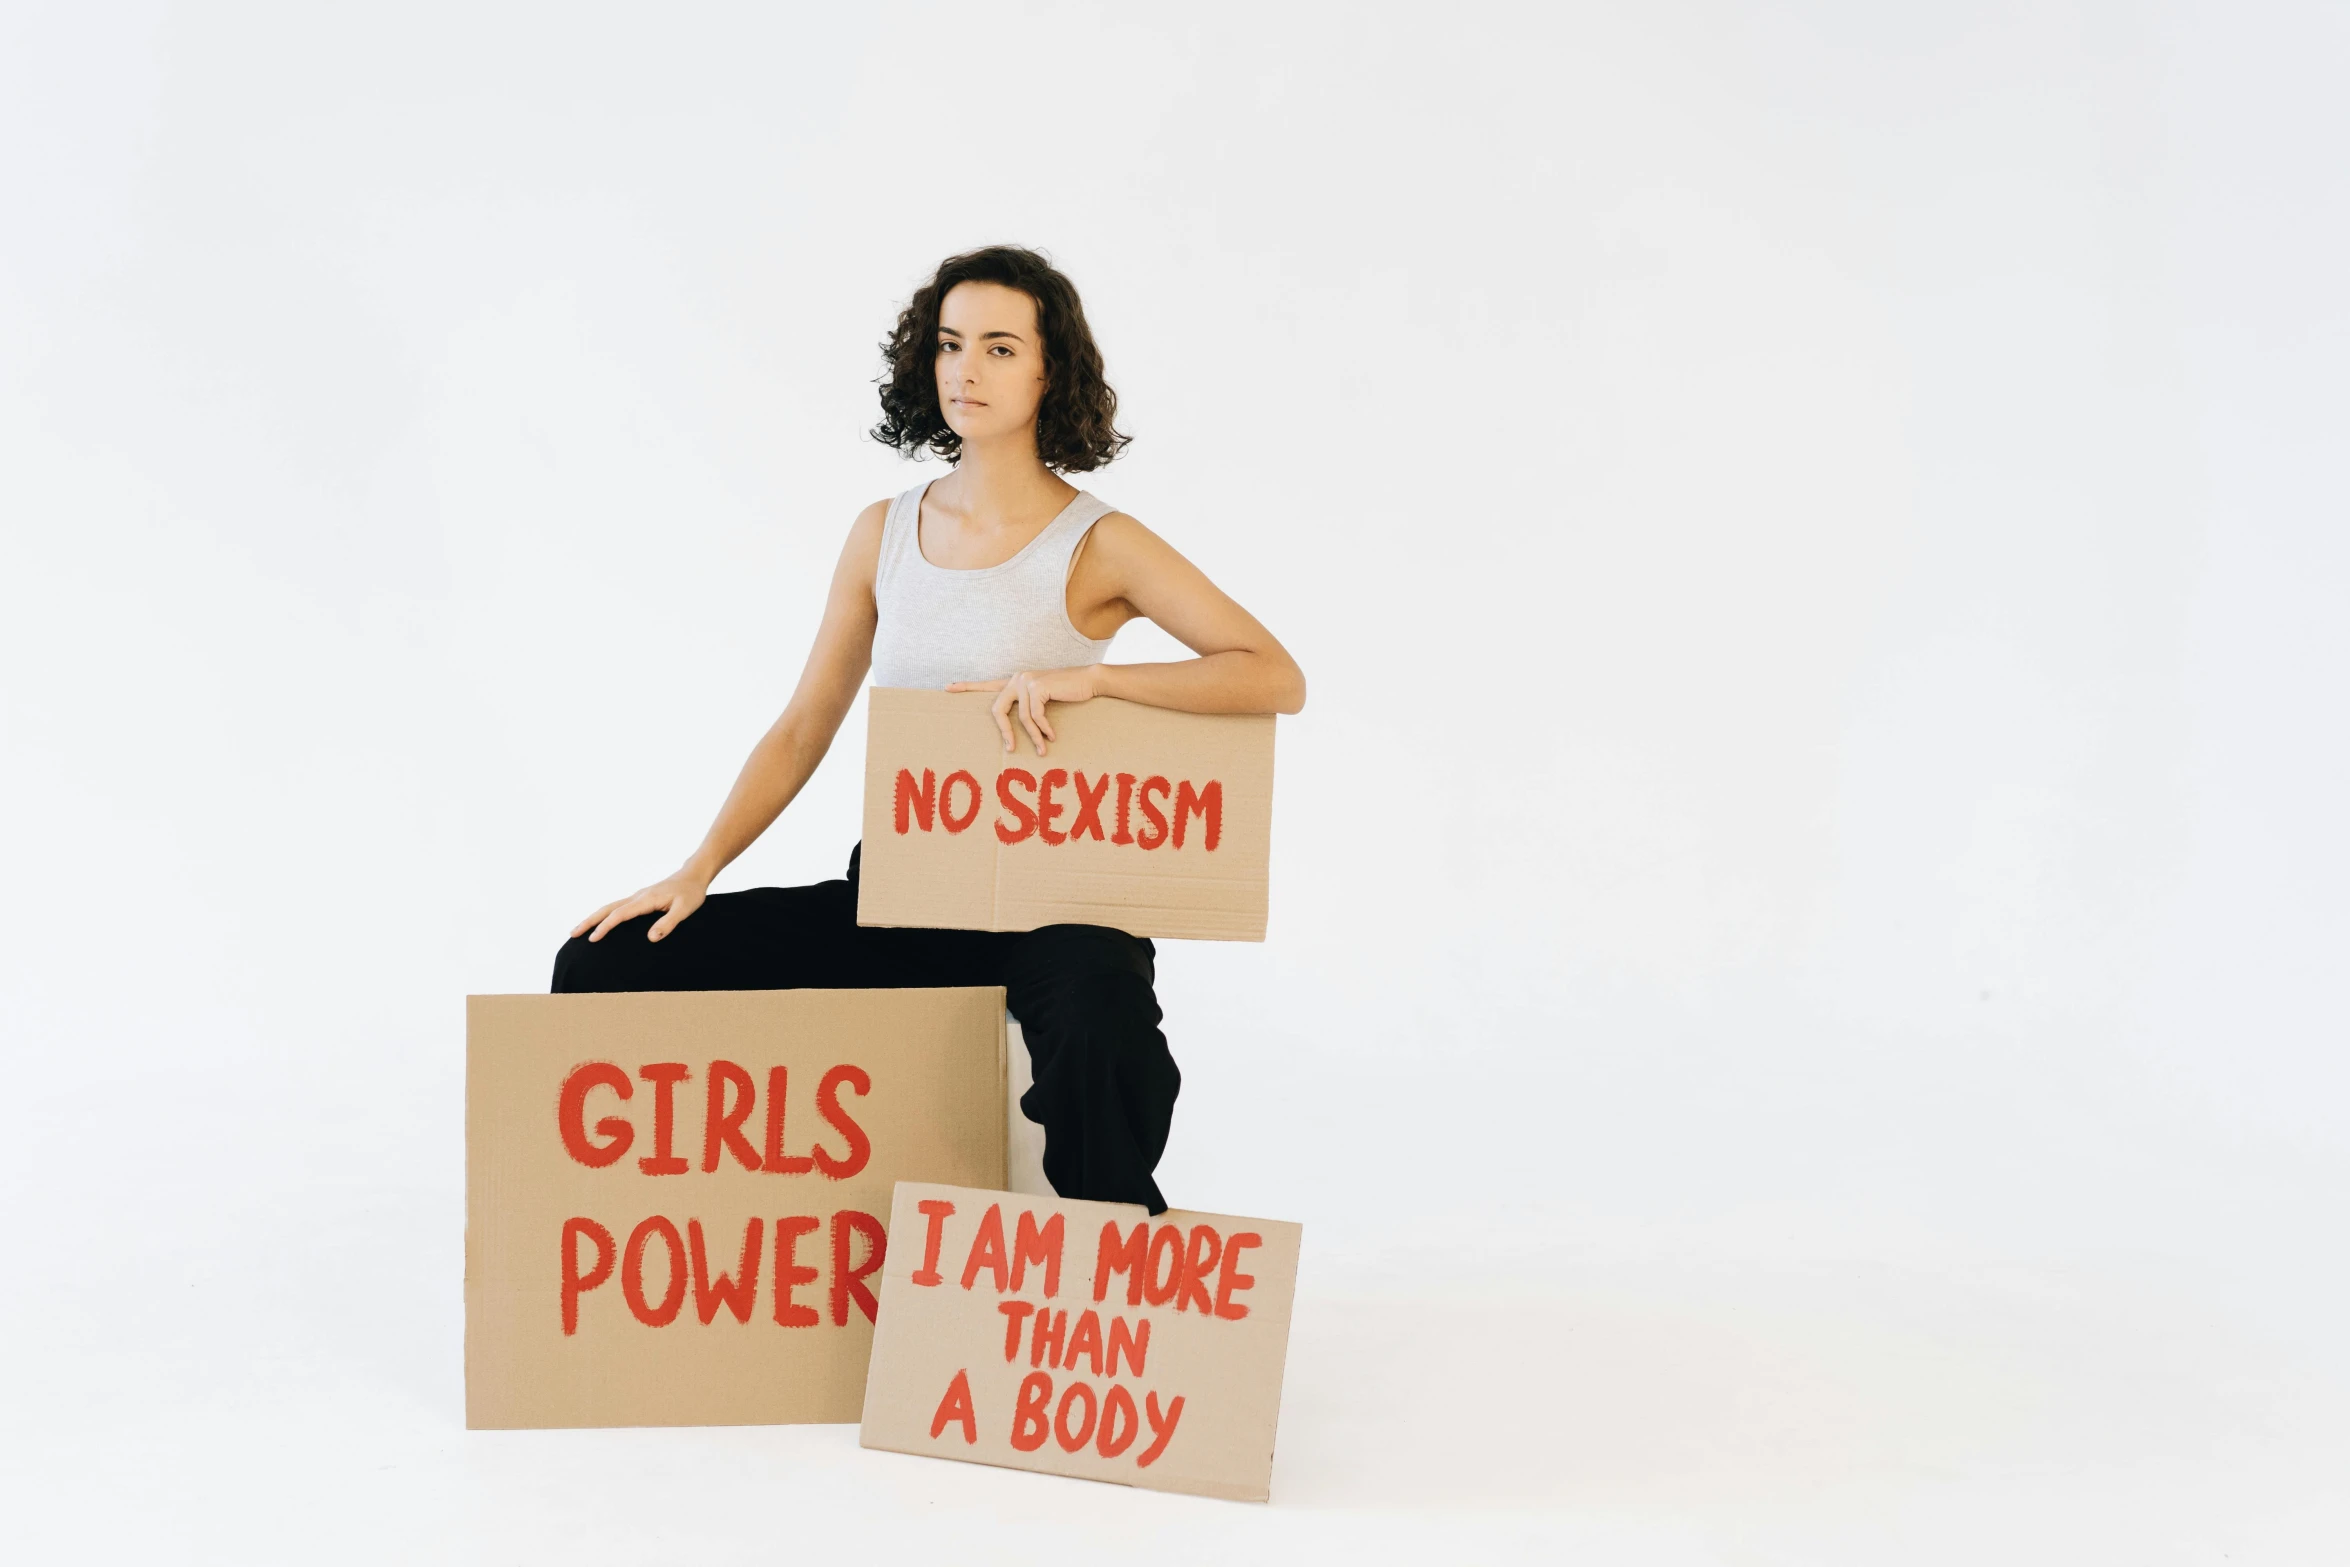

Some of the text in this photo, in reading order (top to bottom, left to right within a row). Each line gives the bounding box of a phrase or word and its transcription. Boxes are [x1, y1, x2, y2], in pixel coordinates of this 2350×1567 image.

[893, 767, 1224, 852] NO SEXISM
[557, 1059, 872, 1180] GIRLS
[560, 1210, 888, 1337] POWER
[911, 1199, 1263, 1321] I AM MORE
[997, 1300, 1152, 1378] THAN
[930, 1368, 1186, 1468] A BODY
